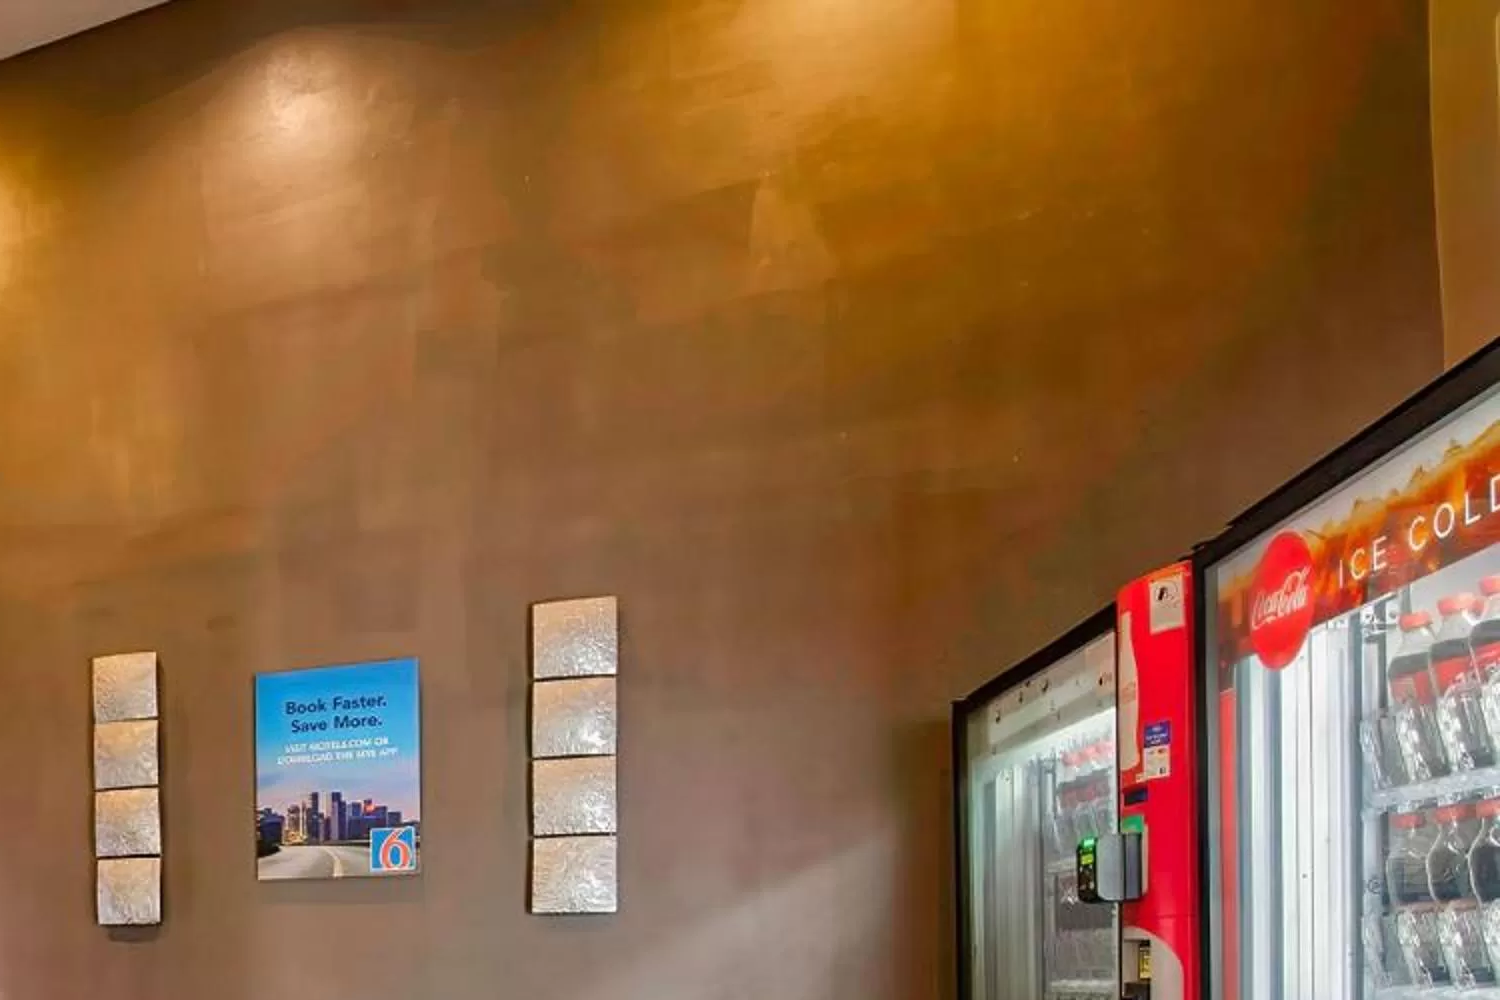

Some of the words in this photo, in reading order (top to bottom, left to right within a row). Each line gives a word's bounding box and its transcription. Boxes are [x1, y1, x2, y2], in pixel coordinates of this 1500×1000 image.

[1338, 535, 1388, 588] ICE
[1252, 566, 1311, 629] Coca-Cola
[285, 698, 327, 714] Book
[332, 696, 387, 710] Faster.
[292, 719, 327, 733] Save
[334, 715, 382, 728] More.
